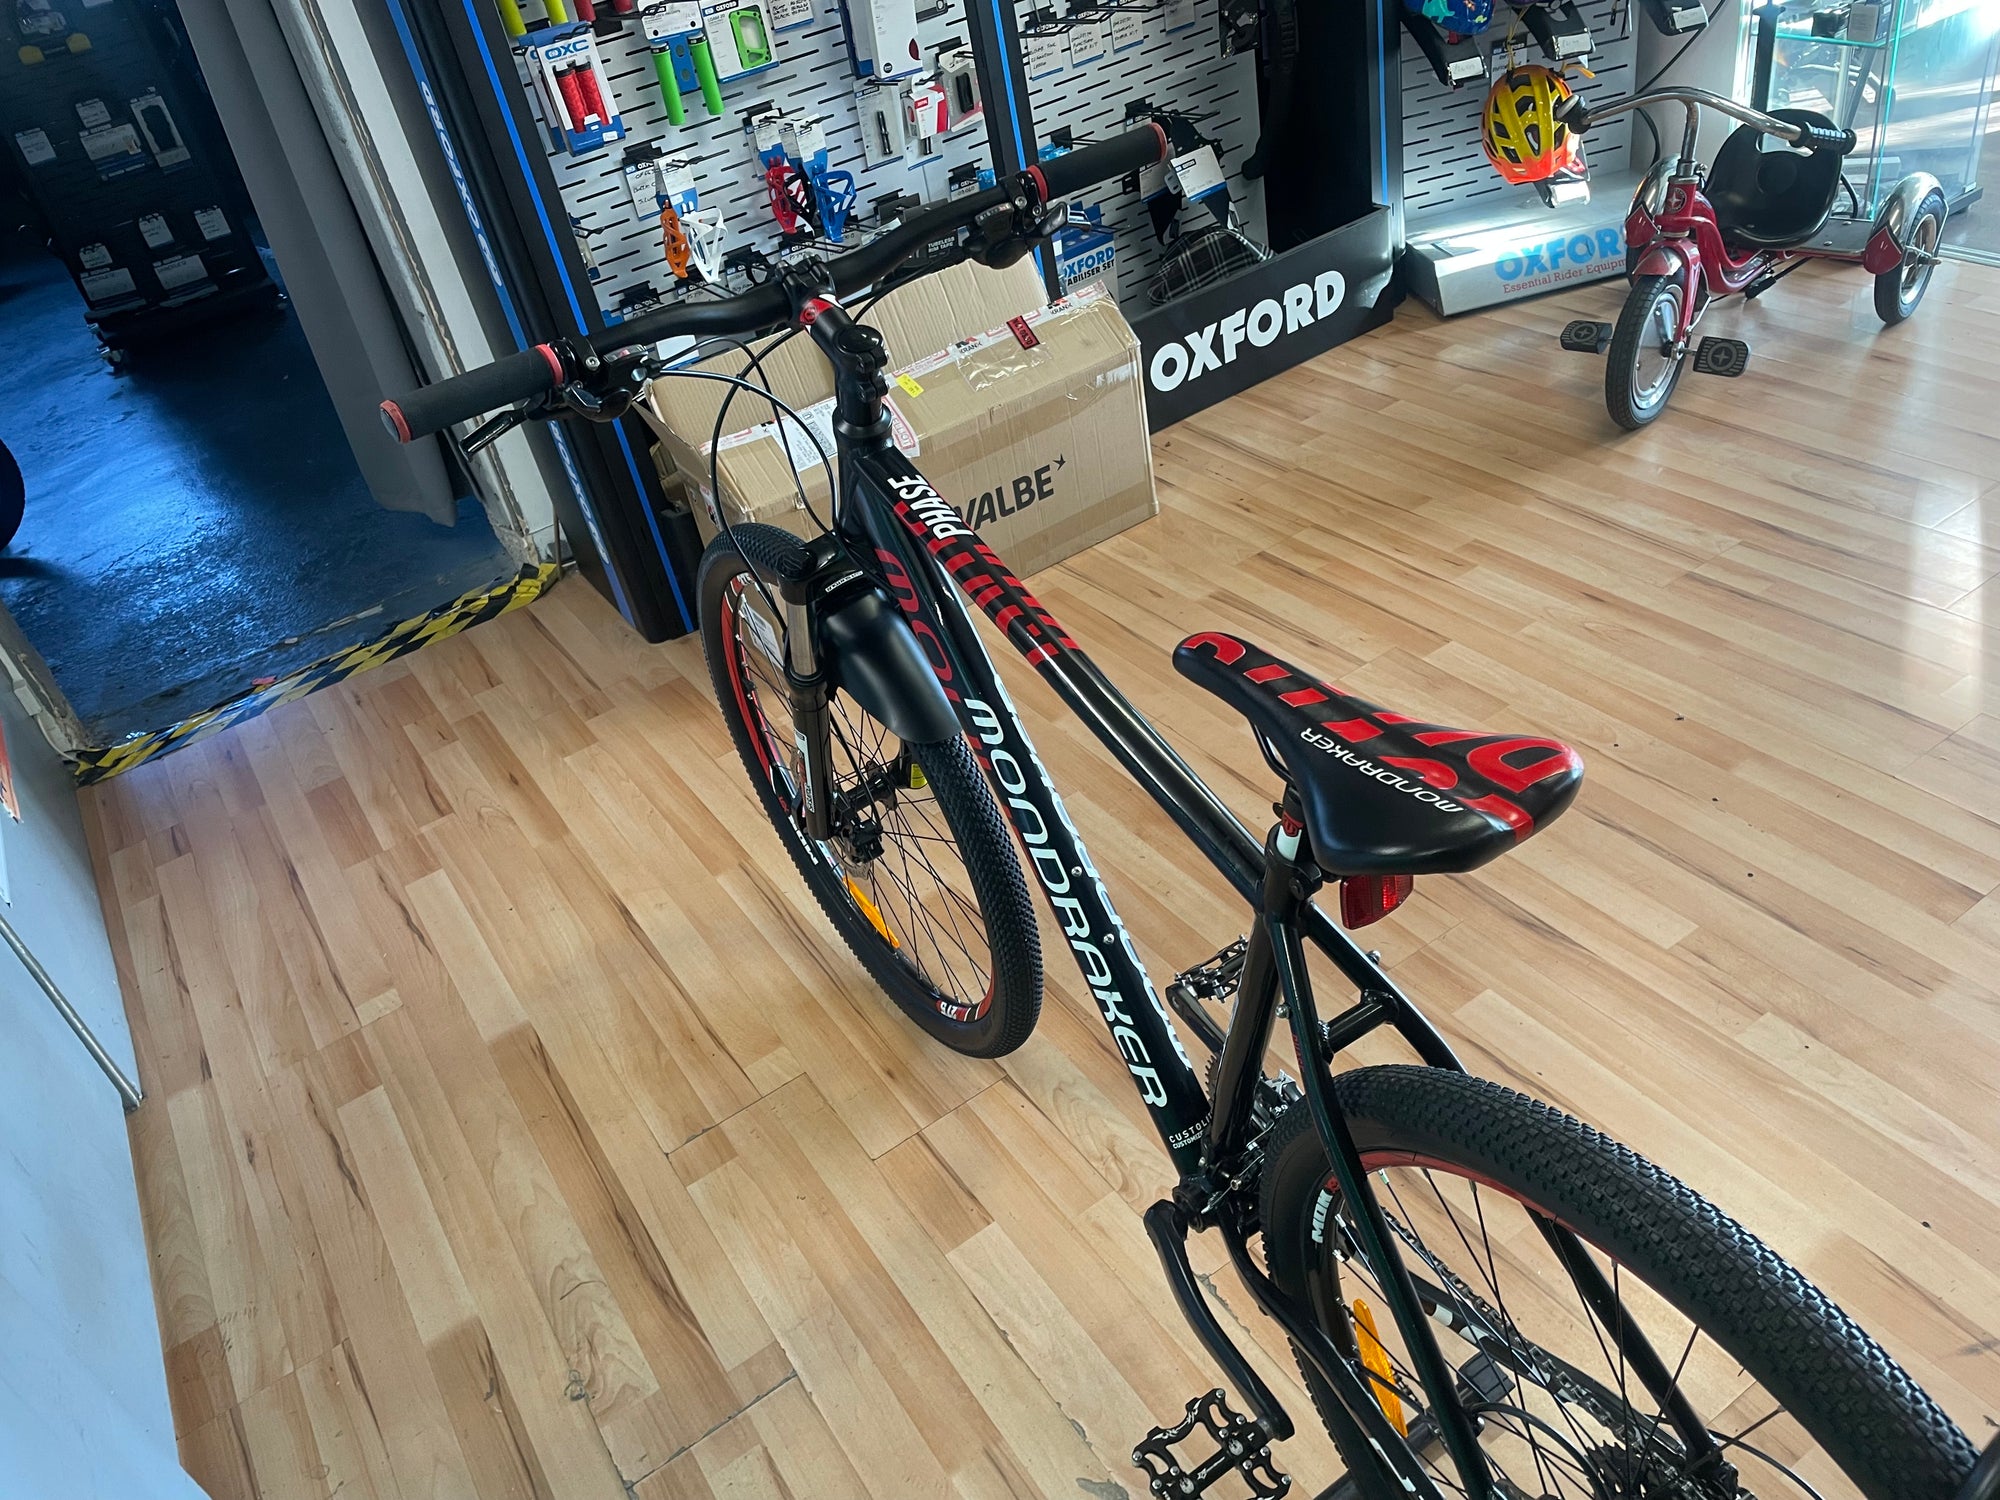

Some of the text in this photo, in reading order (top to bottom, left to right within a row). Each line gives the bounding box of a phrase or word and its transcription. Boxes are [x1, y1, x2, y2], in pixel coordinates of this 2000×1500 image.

[545, 39, 590, 60] OXC
[1102, 260, 1116, 272] SET
[1502, 258, 1627, 295] Essential Rider Equipm
[1150, 270, 1346, 392] OXFORD
[887, 472, 974, 540] PHASE
[1299, 726, 1465, 815] MONDRAKER
